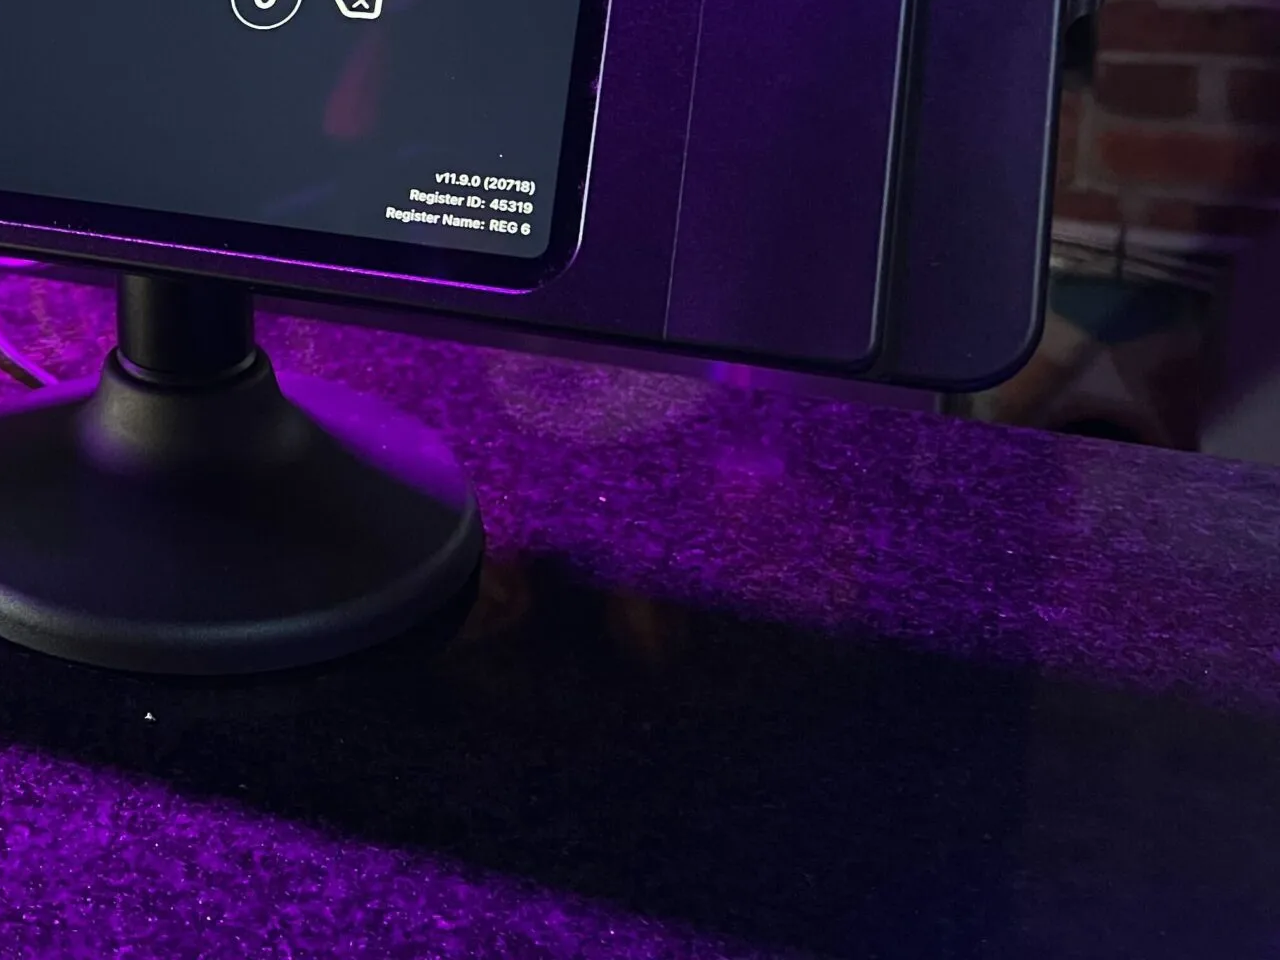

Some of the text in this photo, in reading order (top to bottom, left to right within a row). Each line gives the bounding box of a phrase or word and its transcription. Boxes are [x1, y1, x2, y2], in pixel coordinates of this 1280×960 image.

[435, 172, 536, 196] v11.9.0 (20718)
[409, 189, 534, 215] Register ID: 45319
[385, 206, 531, 236] Register Name: REG 6
